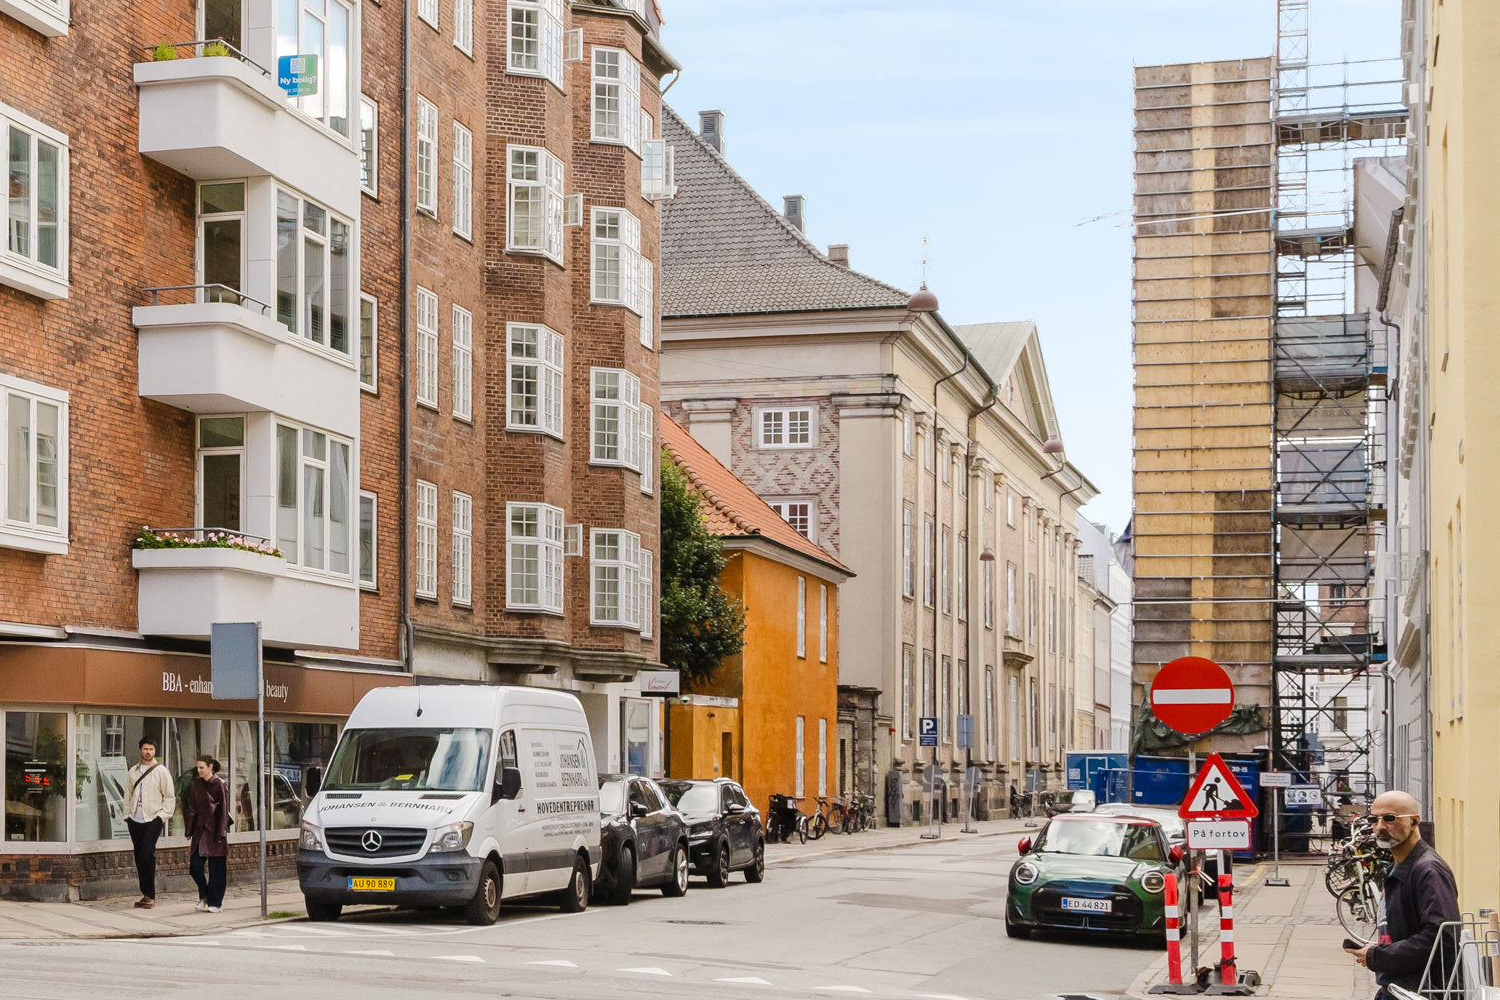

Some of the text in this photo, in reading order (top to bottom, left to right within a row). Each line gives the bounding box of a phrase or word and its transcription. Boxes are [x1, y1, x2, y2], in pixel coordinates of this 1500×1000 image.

[162, 671, 183, 693] BBA
[189, 674, 212, 694] enhan
[266, 680, 289, 703] beauty
[922, 719, 934, 734] P
[318, 801, 376, 815] JOHANSEN
[389, 801, 453, 815] BERNHARD
[536, 799, 595, 815] HOVEDENTREPRENØR
[1193, 827, 1246, 838] På fortov
[353, 878, 394, 888] AU 90 889
[1068, 900, 1109, 911] ED 44 821
